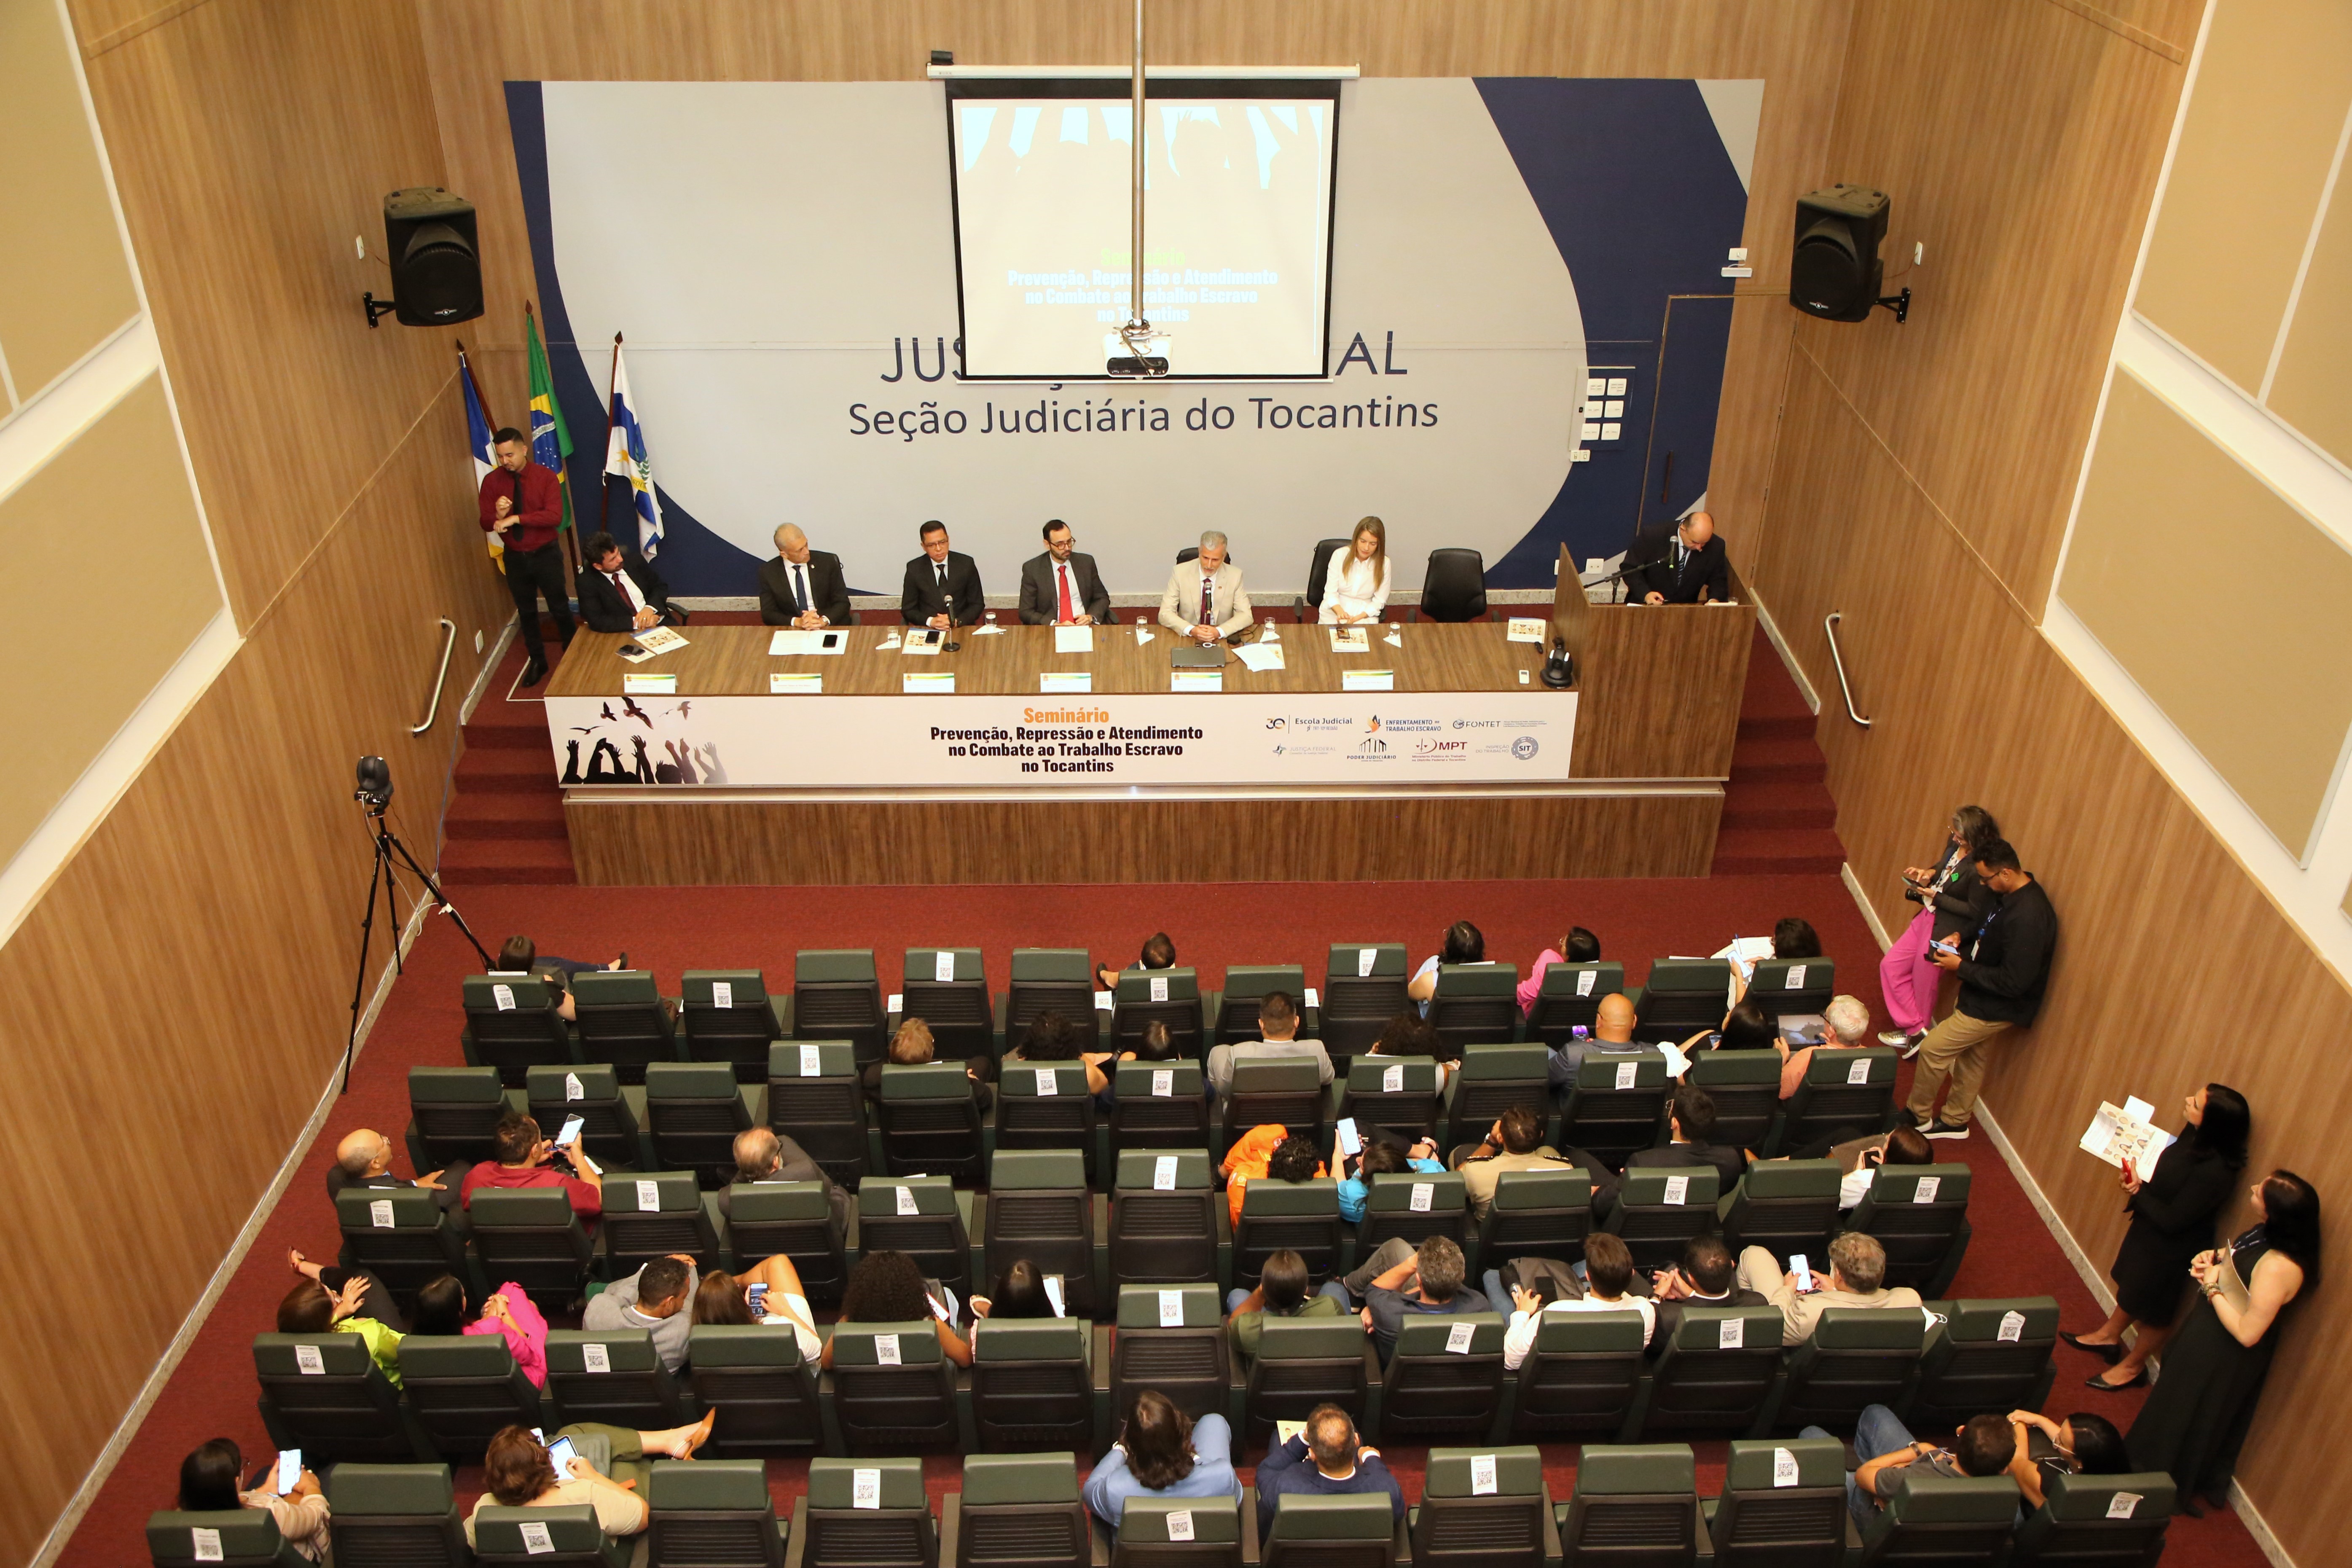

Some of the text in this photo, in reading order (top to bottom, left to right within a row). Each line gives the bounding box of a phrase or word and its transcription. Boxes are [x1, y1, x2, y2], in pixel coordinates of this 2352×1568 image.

[1101, 247, 1185, 266] Semnário
[1008, 268, 1278, 288] Prevenção, Represão e Atendimento
[1026, 287, 1258, 304] no Combate ao rabalho Escravo
[1098, 306, 1190, 322] no Toantins
[850, 396, 1437, 442] Seção Judiciária do Tocantins
[1024, 707, 1109, 723] Seminário
[931, 726, 1203, 743] Prevenção, Repressão e Atendimento
[949, 742, 1182, 756] no Combate ao Trabalho Escravo
[1439, 742, 1468, 750] MPT
[1022, 759, 1114, 772] no Tocantins
